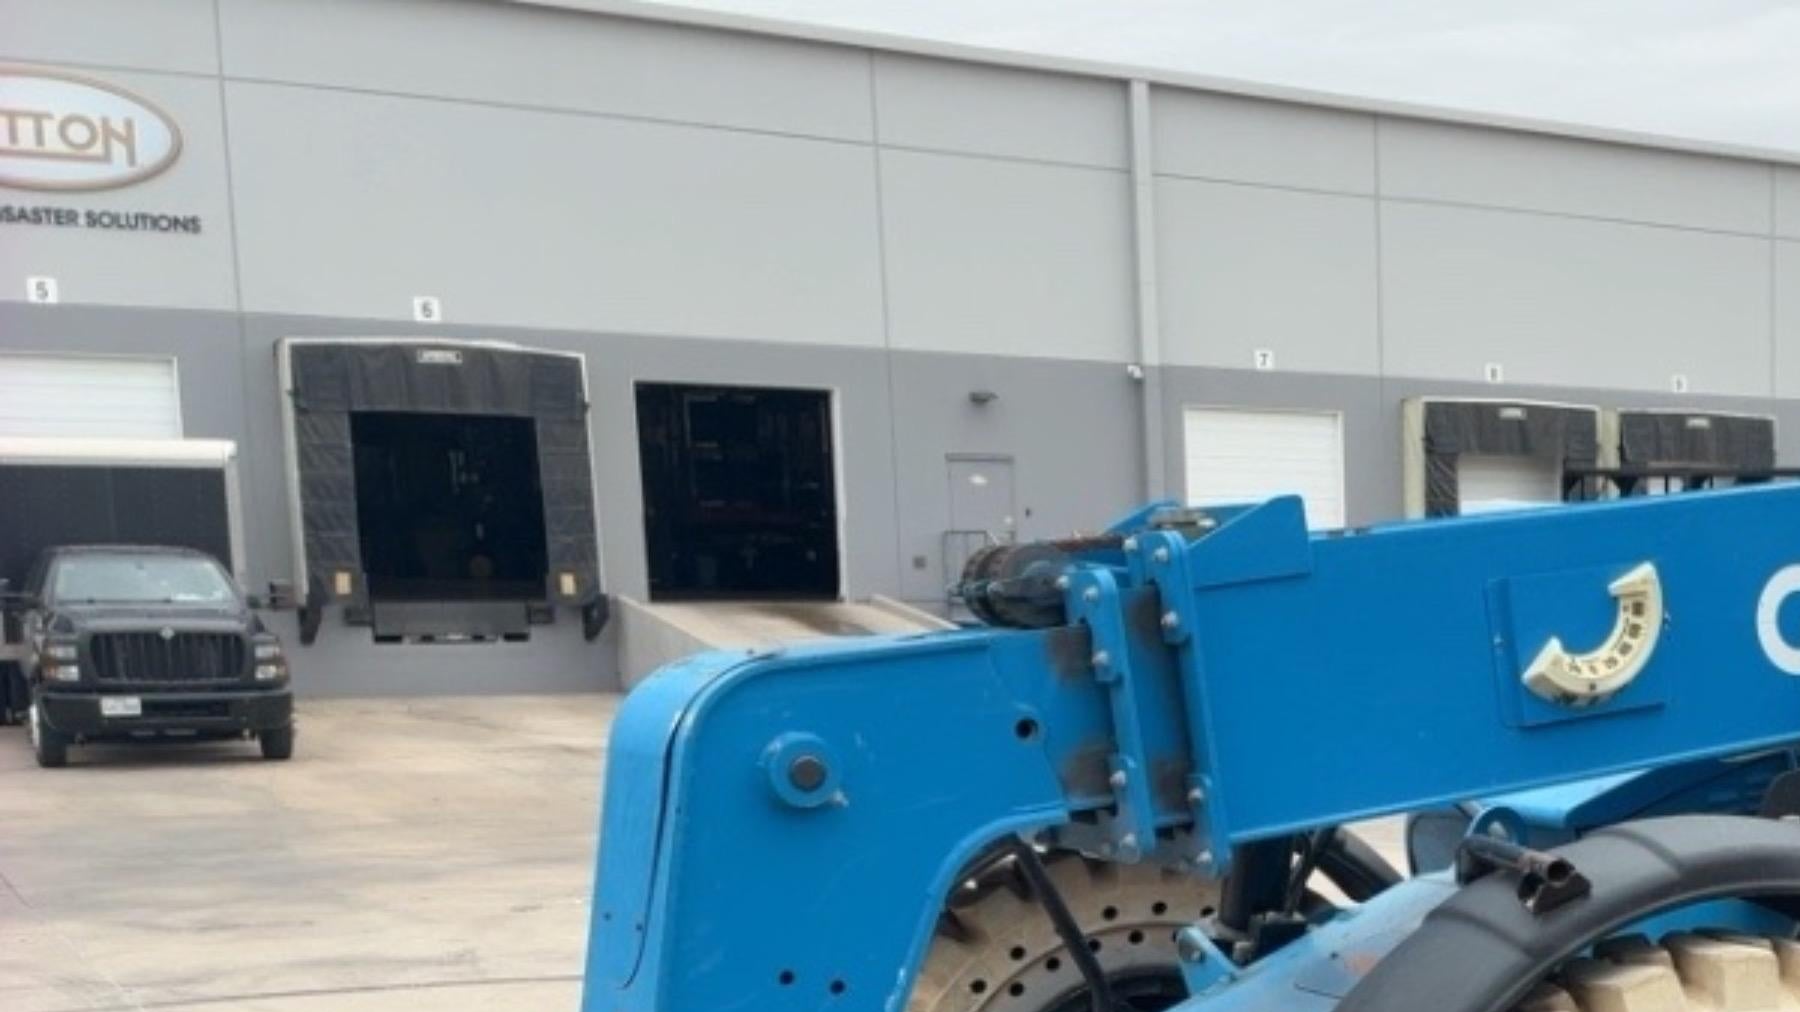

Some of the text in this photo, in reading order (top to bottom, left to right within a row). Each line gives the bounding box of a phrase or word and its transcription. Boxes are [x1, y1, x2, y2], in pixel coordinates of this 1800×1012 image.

[86, 210, 201, 234] SOLUTIONS
[36, 281, 48, 299] 5
[421, 301, 433, 319] 6
